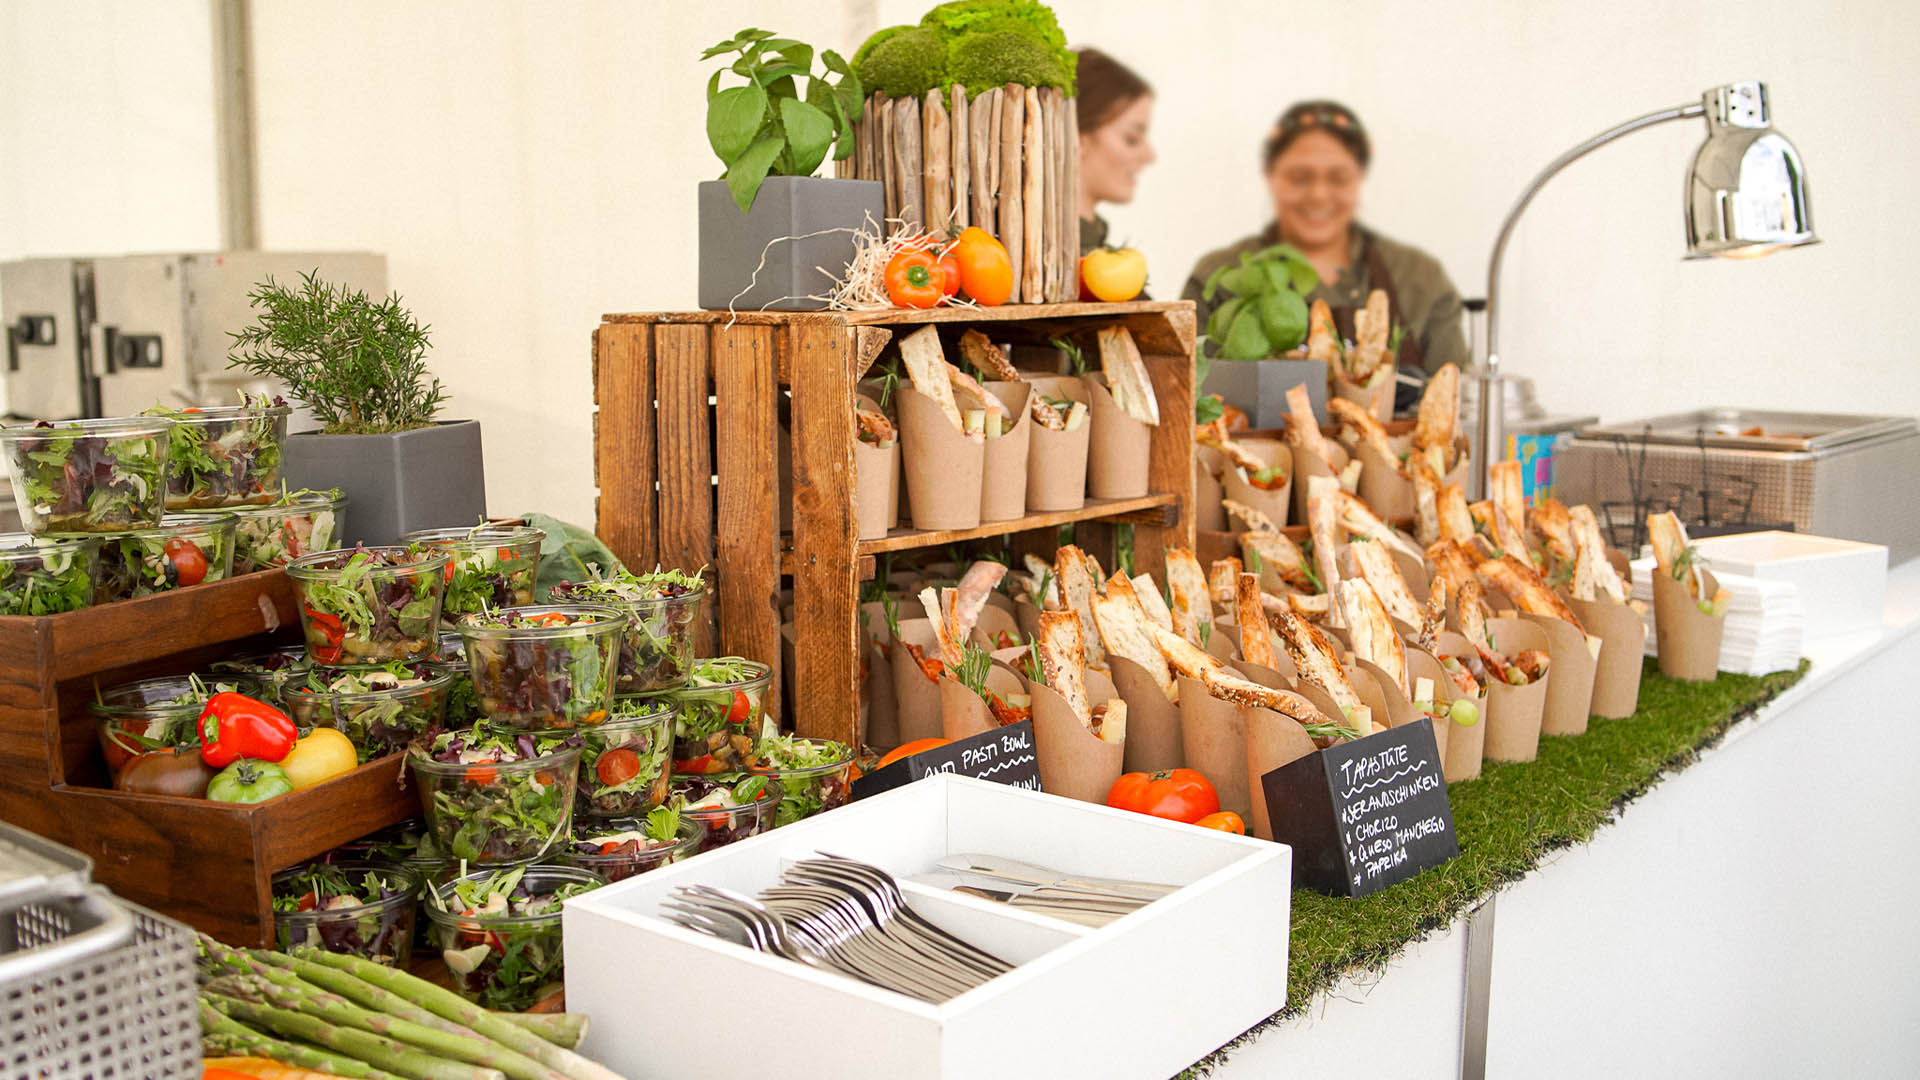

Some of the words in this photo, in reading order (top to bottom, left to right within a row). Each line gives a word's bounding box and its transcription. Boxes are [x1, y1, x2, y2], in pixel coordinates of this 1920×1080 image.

[961, 743, 998, 770] PASTI
[1001, 731, 1031, 753] BOWL
[1341, 745, 1408, 786] TAPASTÜTE
[1356, 815, 1398, 841] CHORIZO
[1358, 838, 1393, 863] QUESO
[1395, 815, 1445, 847] MANCHEGO
[1365, 846, 1408, 880] PAPRIKA
